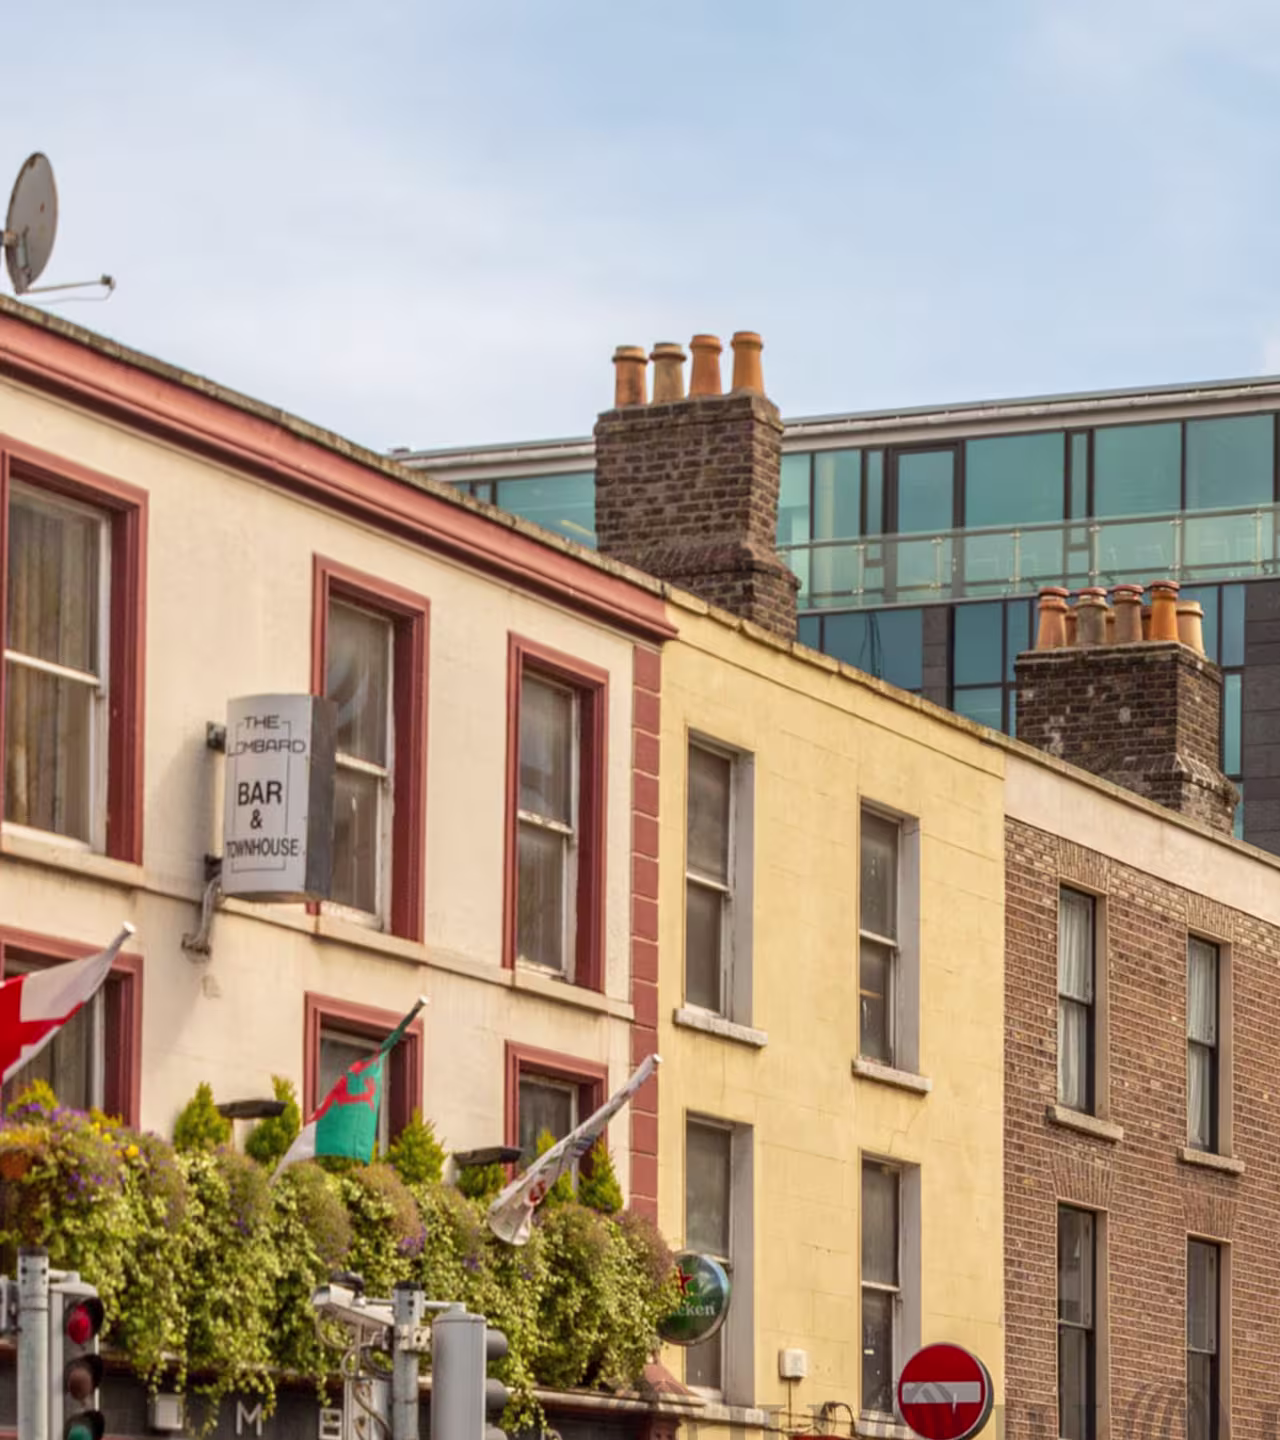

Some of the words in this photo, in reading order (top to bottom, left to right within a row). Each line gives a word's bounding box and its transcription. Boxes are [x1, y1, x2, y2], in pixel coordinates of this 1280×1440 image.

[243, 714, 280, 730] THE
[227, 738, 307, 757] LOMBARD
[237, 780, 283, 806] BAR
[250, 808, 263, 830] &
[226, 837, 299, 859] TOWNHOUSE
